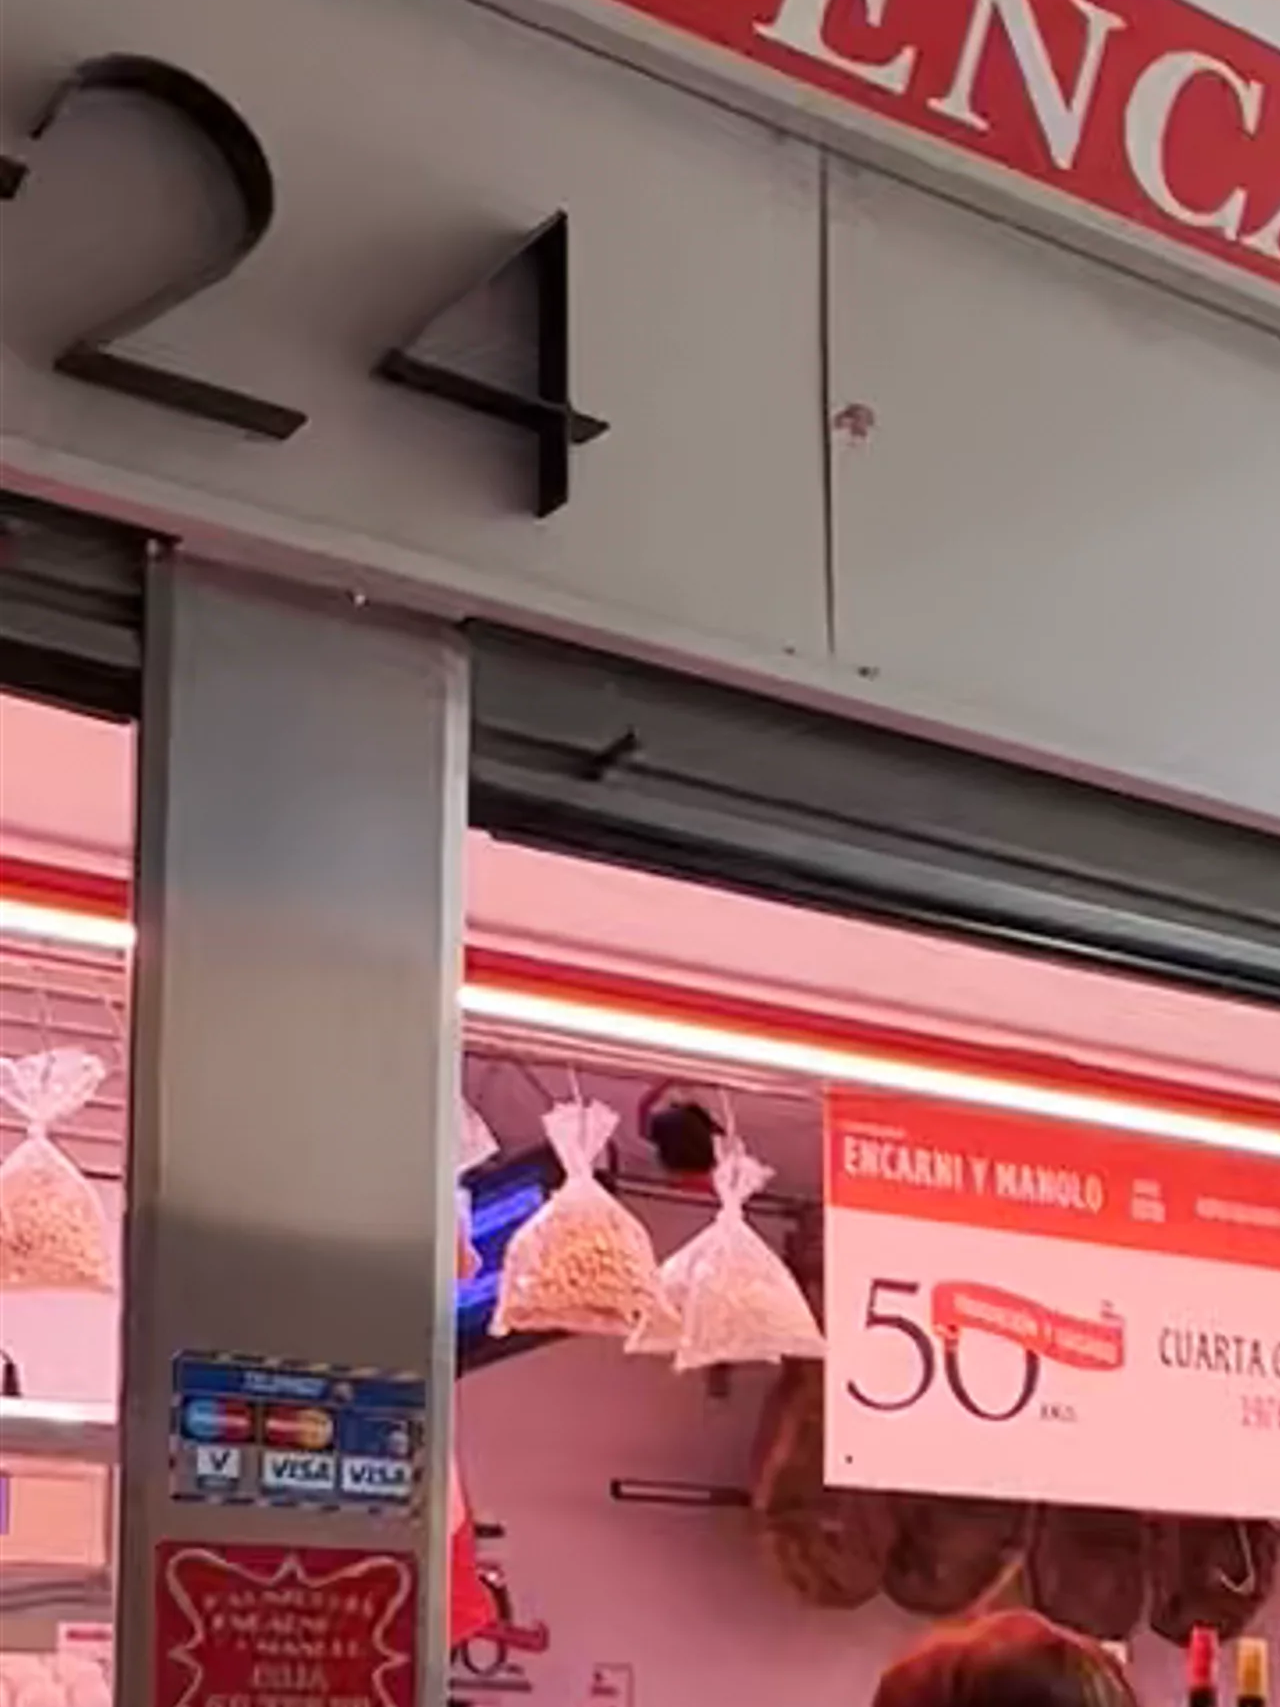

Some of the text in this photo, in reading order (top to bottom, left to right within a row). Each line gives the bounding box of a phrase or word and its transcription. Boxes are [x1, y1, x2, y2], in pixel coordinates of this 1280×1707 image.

[844, 1134, 963, 1194] ENCARNI
[846, 1277, 1040, 1421] 50
[1158, 1326, 1267, 1378] CUARTA
[271, 1457, 331, 1481] VISA
